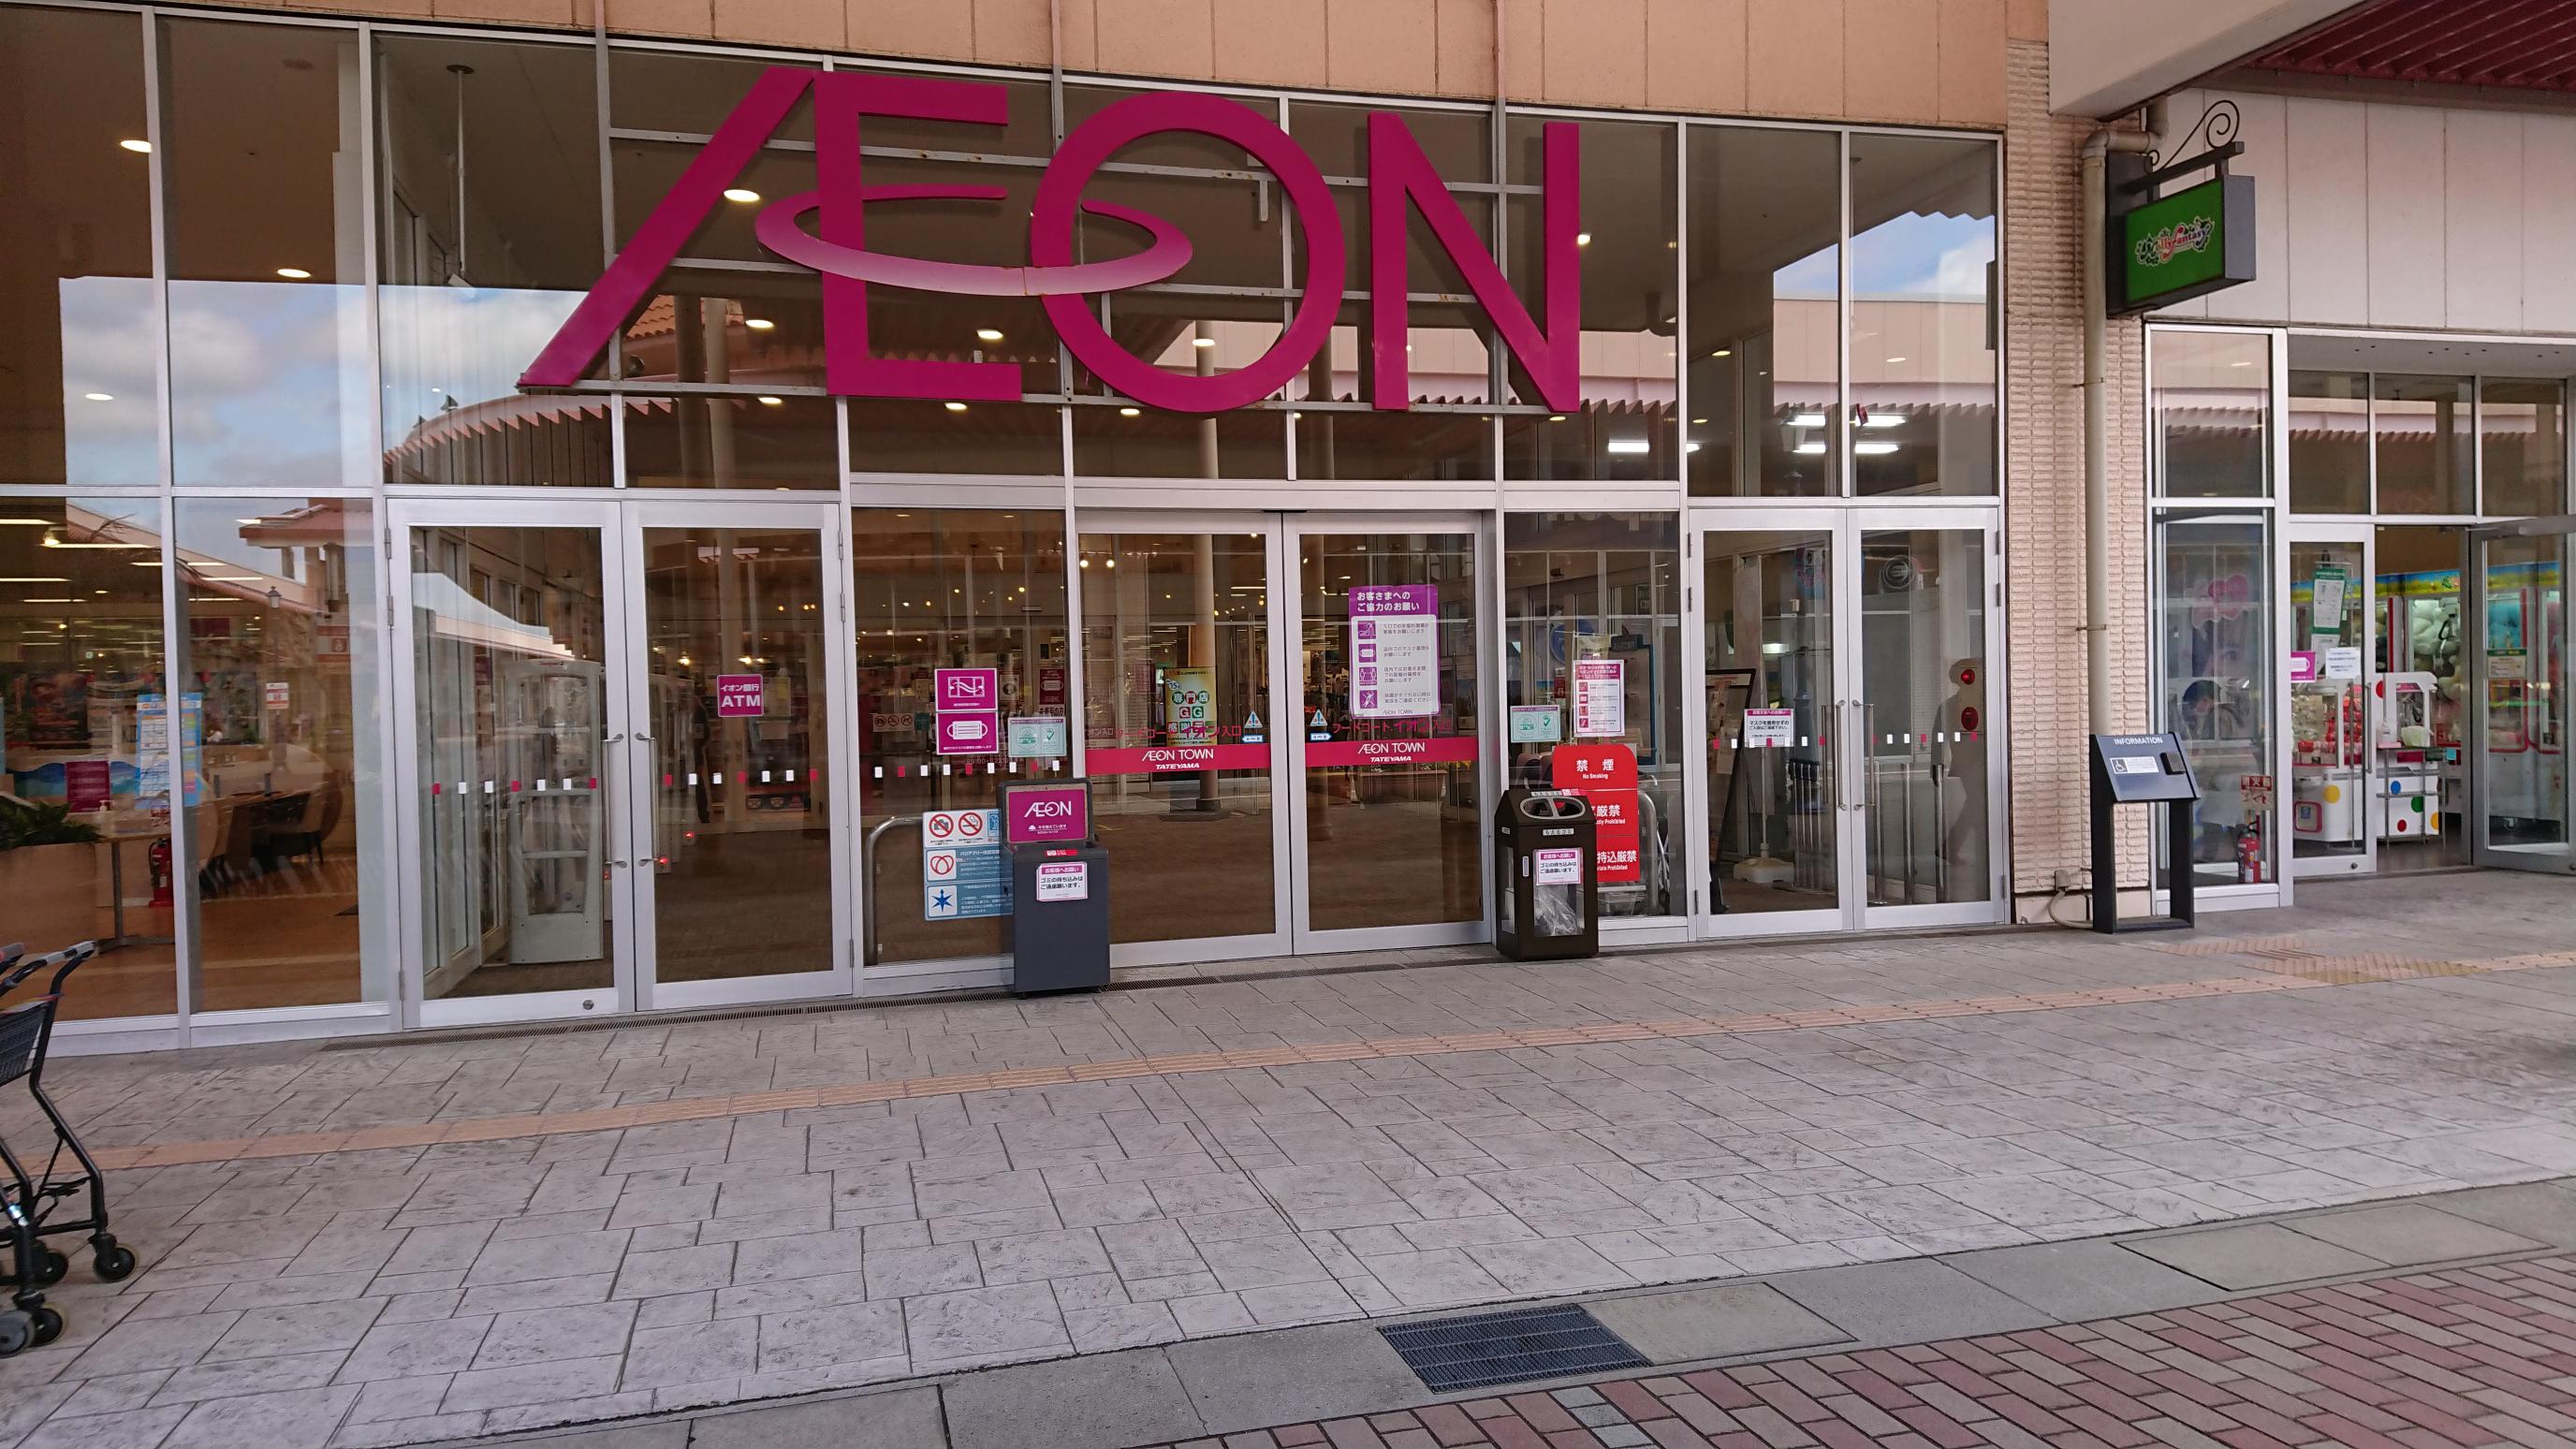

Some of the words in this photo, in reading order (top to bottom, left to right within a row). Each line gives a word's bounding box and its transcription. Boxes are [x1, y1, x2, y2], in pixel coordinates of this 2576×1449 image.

[1357, 592, 1411, 601] お客さまへの
[1357, 602, 1420, 612] ご協力のお願い
[720, 683, 760, 692] イオン銀行
[721, 695, 761, 708] ATM
[2114, 737, 2163, 745] INFORMATION
[1391, 741, 1426, 753] TOWN
[1178, 748, 1214, 761] TOWN
[1041, 875, 1084, 885] ゴミの持ち込みは
